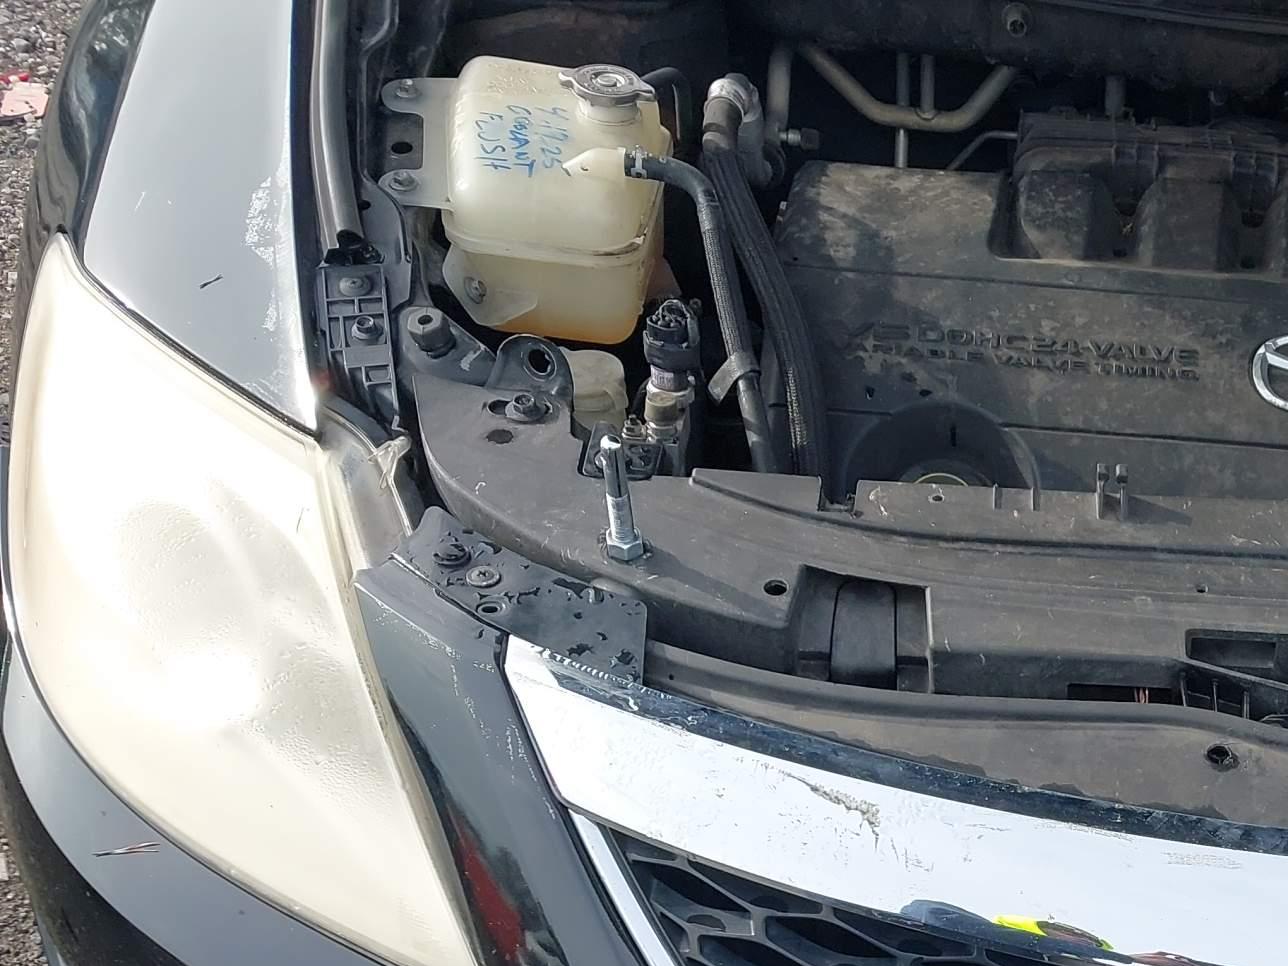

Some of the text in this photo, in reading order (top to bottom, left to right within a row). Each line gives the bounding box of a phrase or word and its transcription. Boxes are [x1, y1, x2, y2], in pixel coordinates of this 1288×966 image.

[474, 111, 512, 170] FLUSH
[915, 325, 1028, 350] DOHC
[991, 351, 1091, 374] VALVE
[1094, 359, 1200, 382] TIMING
